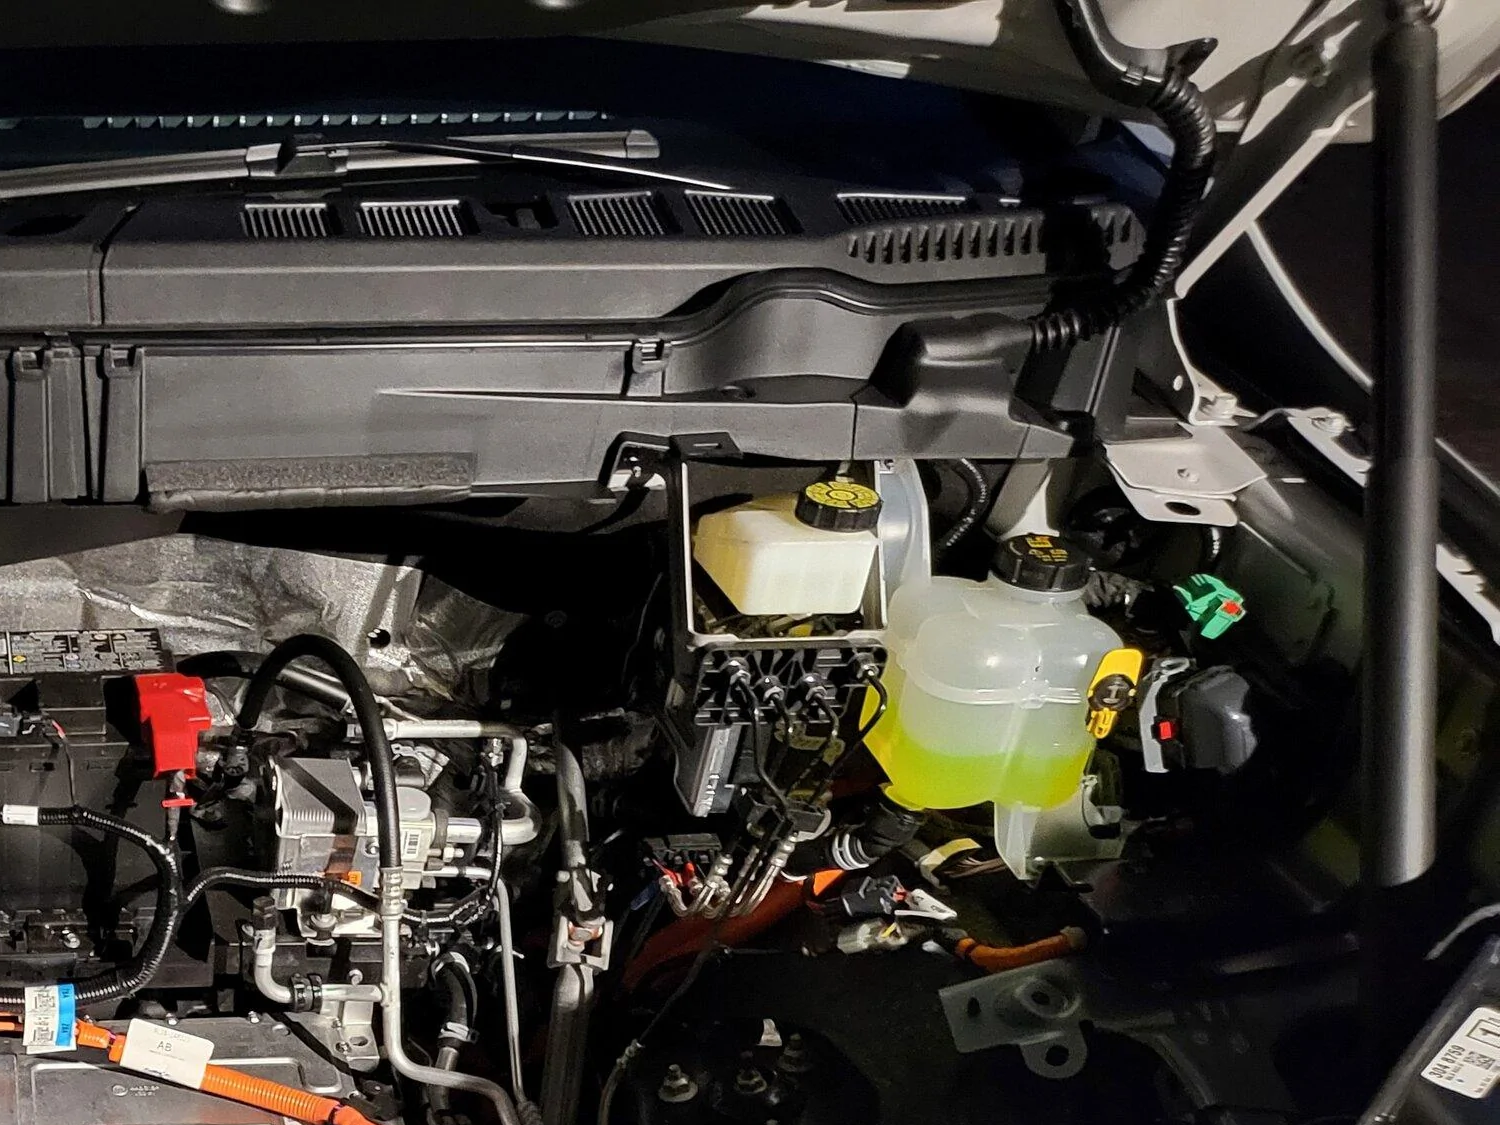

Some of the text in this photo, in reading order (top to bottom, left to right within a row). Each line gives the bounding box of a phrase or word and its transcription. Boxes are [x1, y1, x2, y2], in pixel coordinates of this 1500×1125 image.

[156, 1041, 173, 1052] AB
[1429, 1063, 1450, 1078] 304
[1441, 1045, 1465, 1063] 8759
